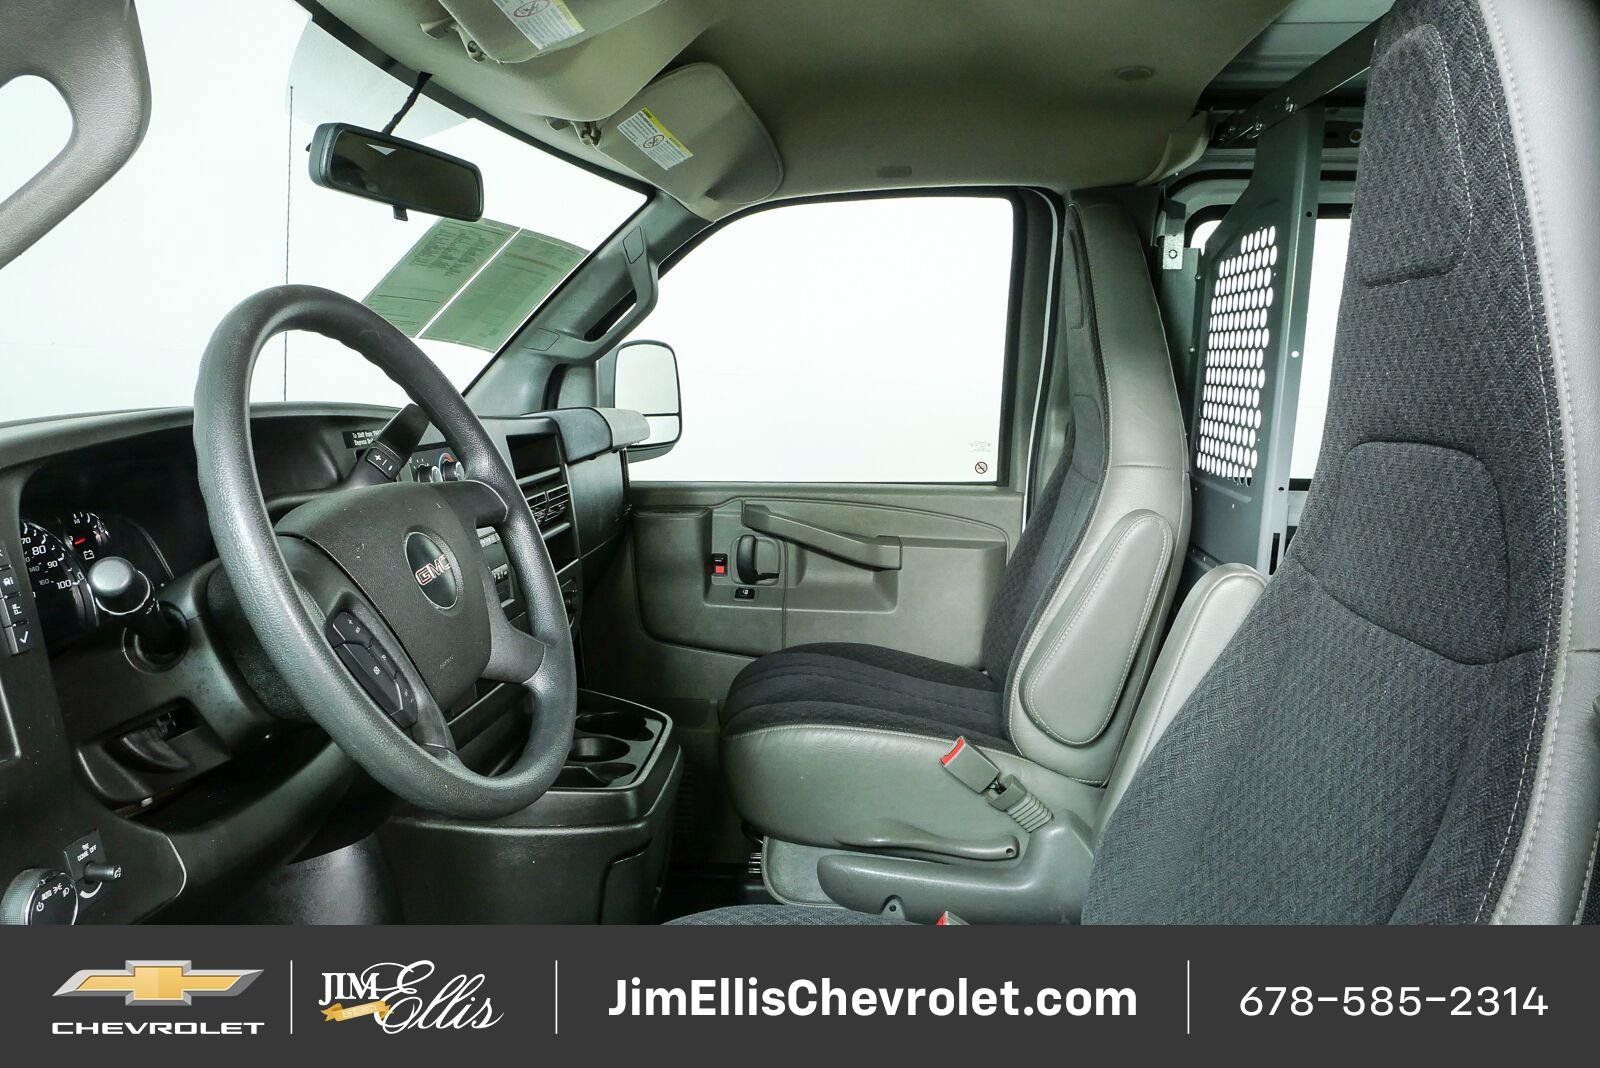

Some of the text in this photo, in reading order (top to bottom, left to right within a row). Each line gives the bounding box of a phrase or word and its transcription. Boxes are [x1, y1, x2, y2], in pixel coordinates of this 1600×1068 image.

[21, 536, 31, 544] 70
[32, 545, 47, 556] 80
[47, 560, 58, 569] 90
[415, 554, 452, 586] GMC
[56, 579, 72, 590] 100
